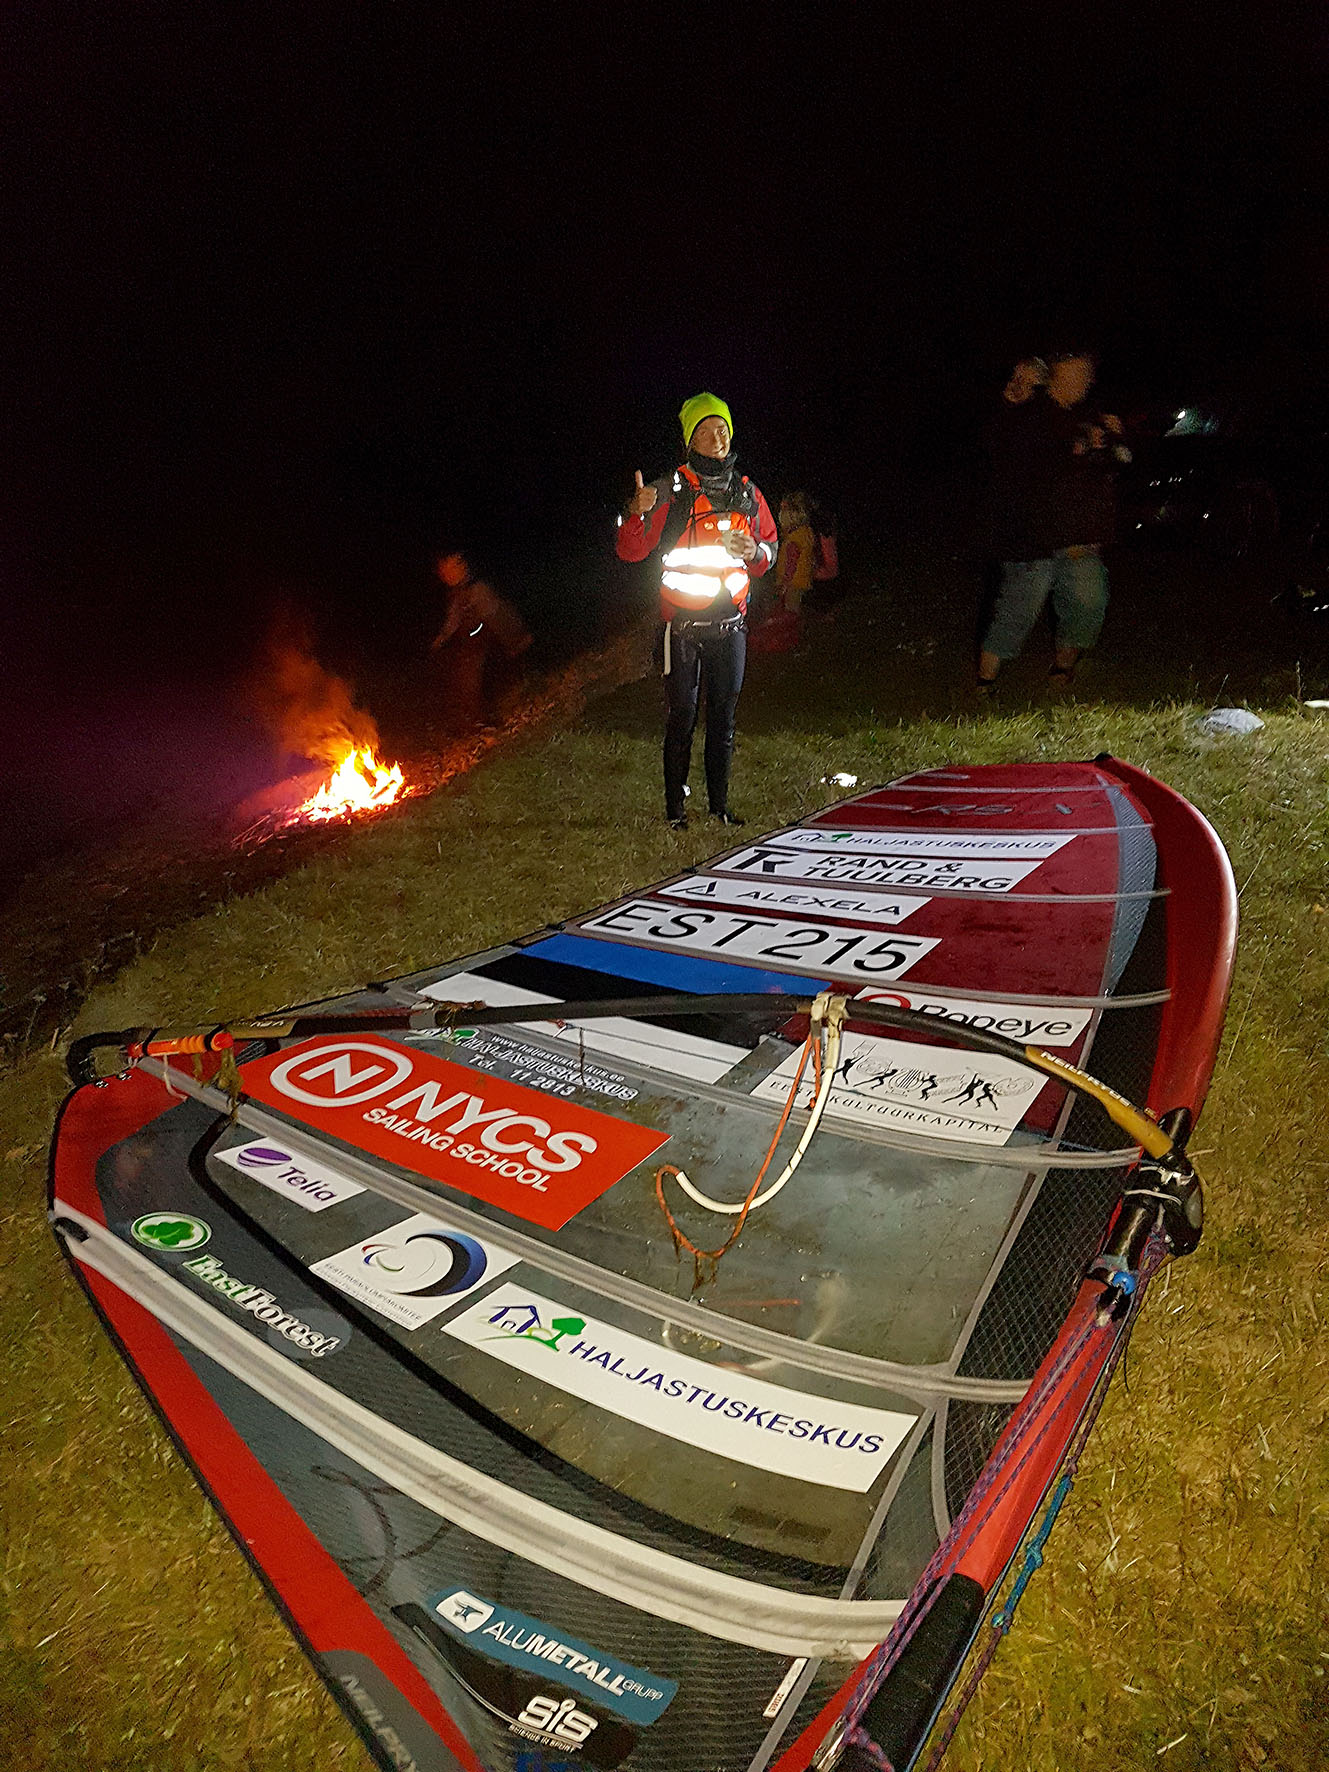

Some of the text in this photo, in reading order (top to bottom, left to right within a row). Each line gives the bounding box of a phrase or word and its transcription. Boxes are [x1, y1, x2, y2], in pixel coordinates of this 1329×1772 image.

[803, 866, 1012, 892] TUULBERG
[817, 857, 964, 873] RAND &
[739, 890, 902, 917] ALEXELA
[596, 905, 922, 973] EST 215
[385, 1080, 599, 1173] NYCS
[769, 1081, 1002, 1133] EEST KULTUURKAPITAL
[362, 1106, 548, 1193] SAILING SCHOOL
[280, 1165, 338, 1204] Telia
[181, 1254, 341, 1358] EastForest
[569, 1338, 884, 1456] HALJASTUSKESKUS
[482, 1618, 664, 1702] ALUMETALL GRUPP
[508, 1723, 541, 1743] SCIENCE
